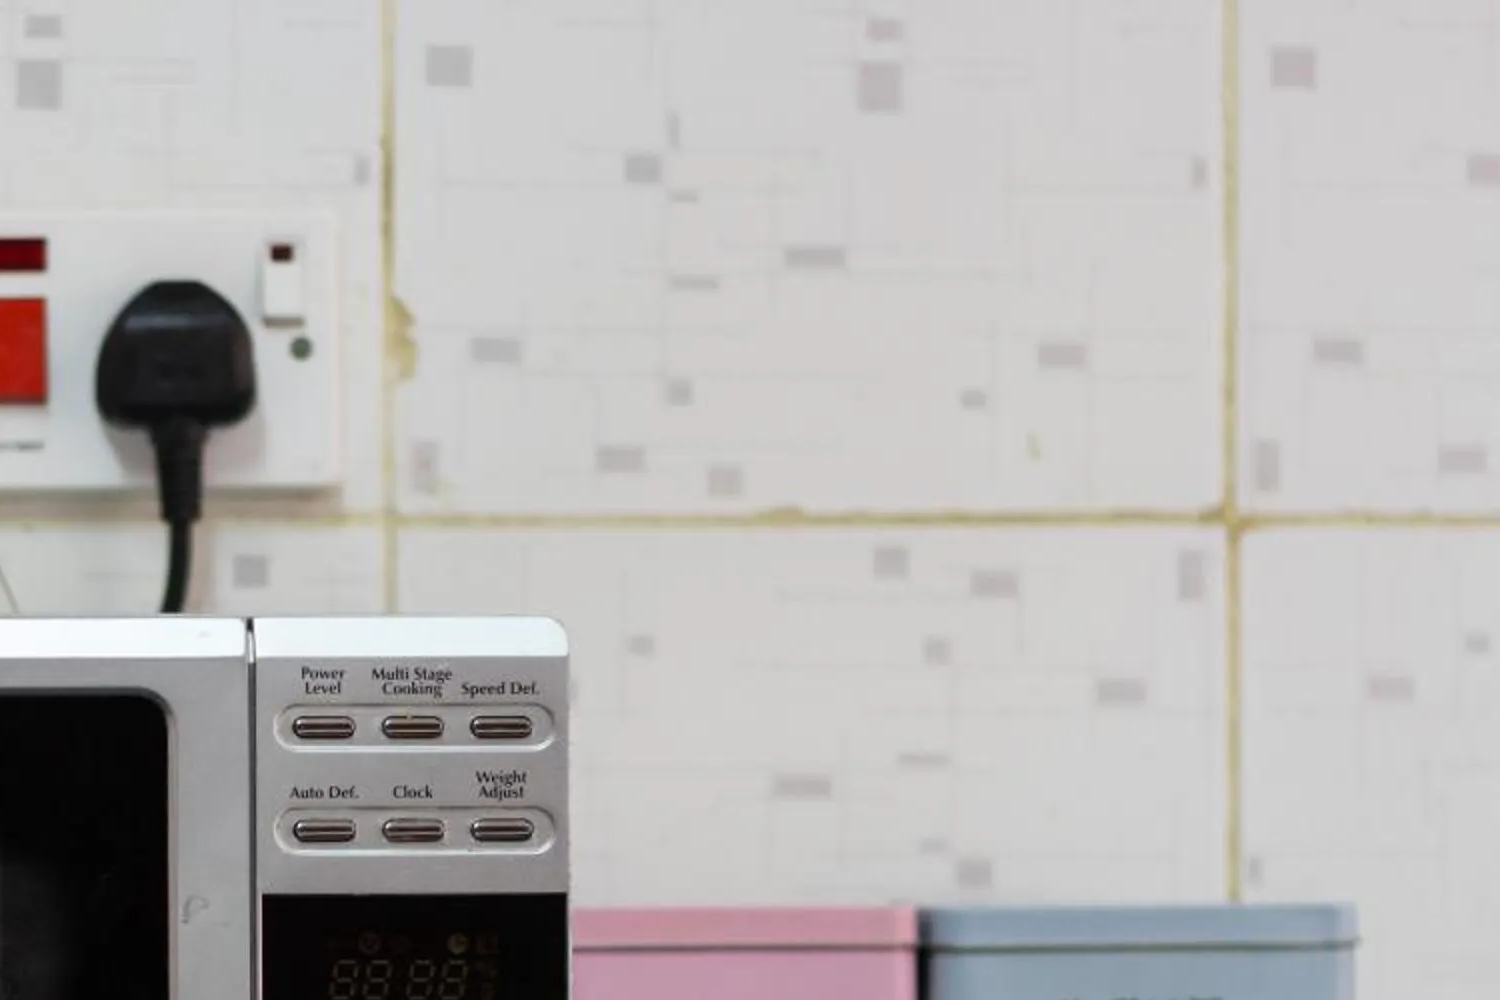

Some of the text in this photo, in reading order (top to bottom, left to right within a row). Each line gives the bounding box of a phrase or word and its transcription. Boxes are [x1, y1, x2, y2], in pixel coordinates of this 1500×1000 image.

[301, 667, 347, 680] Power
[372, 667, 453, 683] Multi Stage
[305, 681, 342, 695] Level
[382, 681, 443, 698] Cooking
[461, 681, 541, 697] Speed Def.
[476, 770, 527, 787] Weight
[289, 785, 360, 799] Auto Def.
[393, 785, 434, 799] Clock
[478, 785, 524, 802] Adjust
